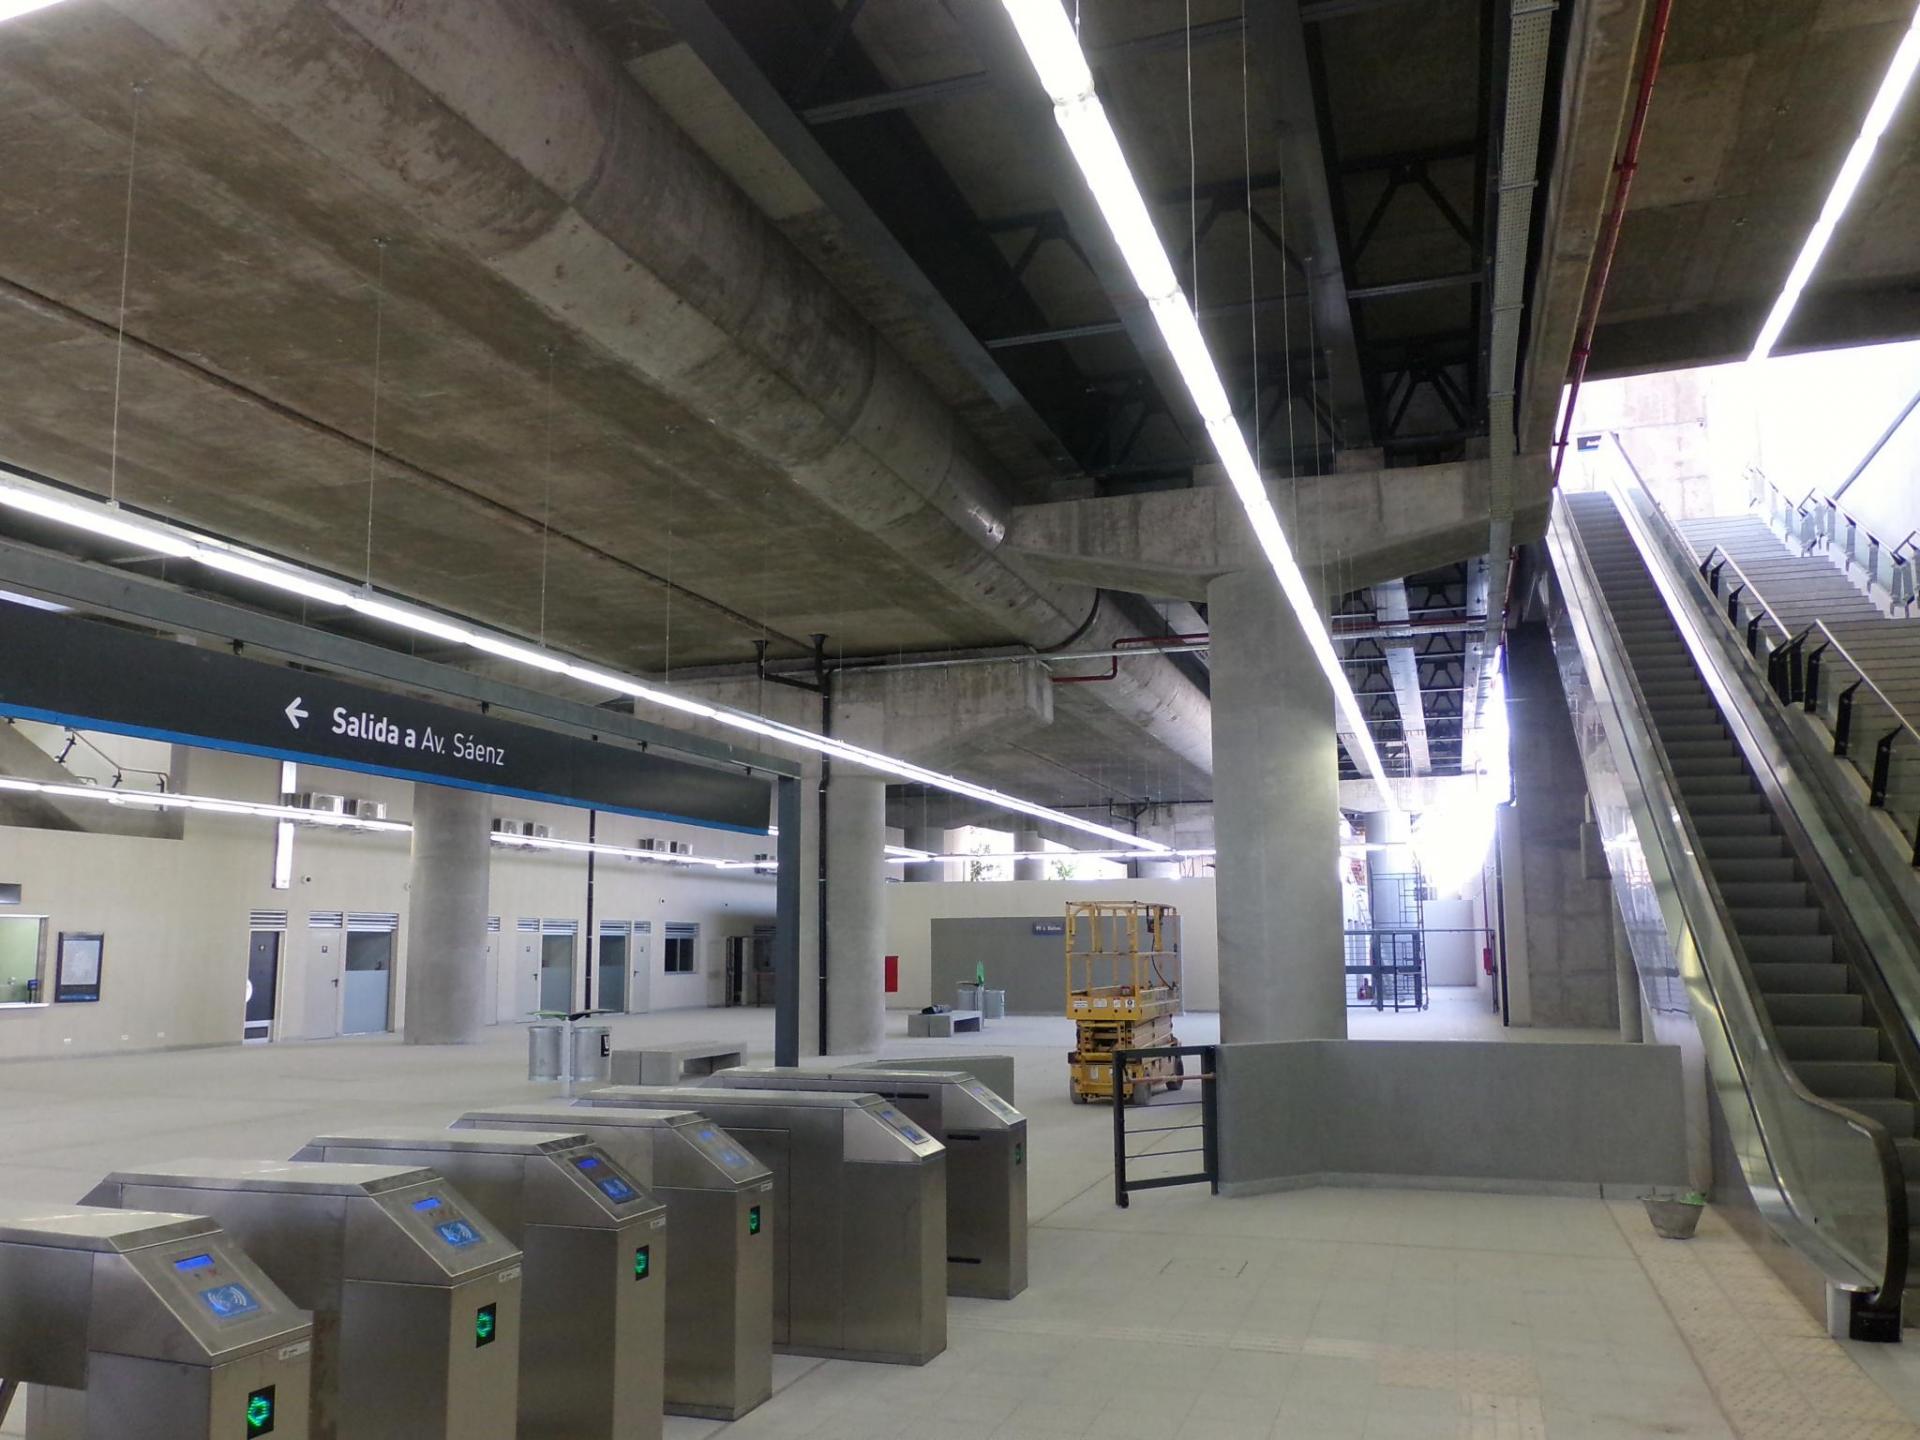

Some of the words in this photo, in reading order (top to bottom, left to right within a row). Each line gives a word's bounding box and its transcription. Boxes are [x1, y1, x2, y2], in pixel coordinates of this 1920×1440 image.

[331, 706, 399, 745] Salida
[404, 728, 416, 748] a
[421, 727, 446, 755] Av.
[453, 733, 505, 766] Sáenz
